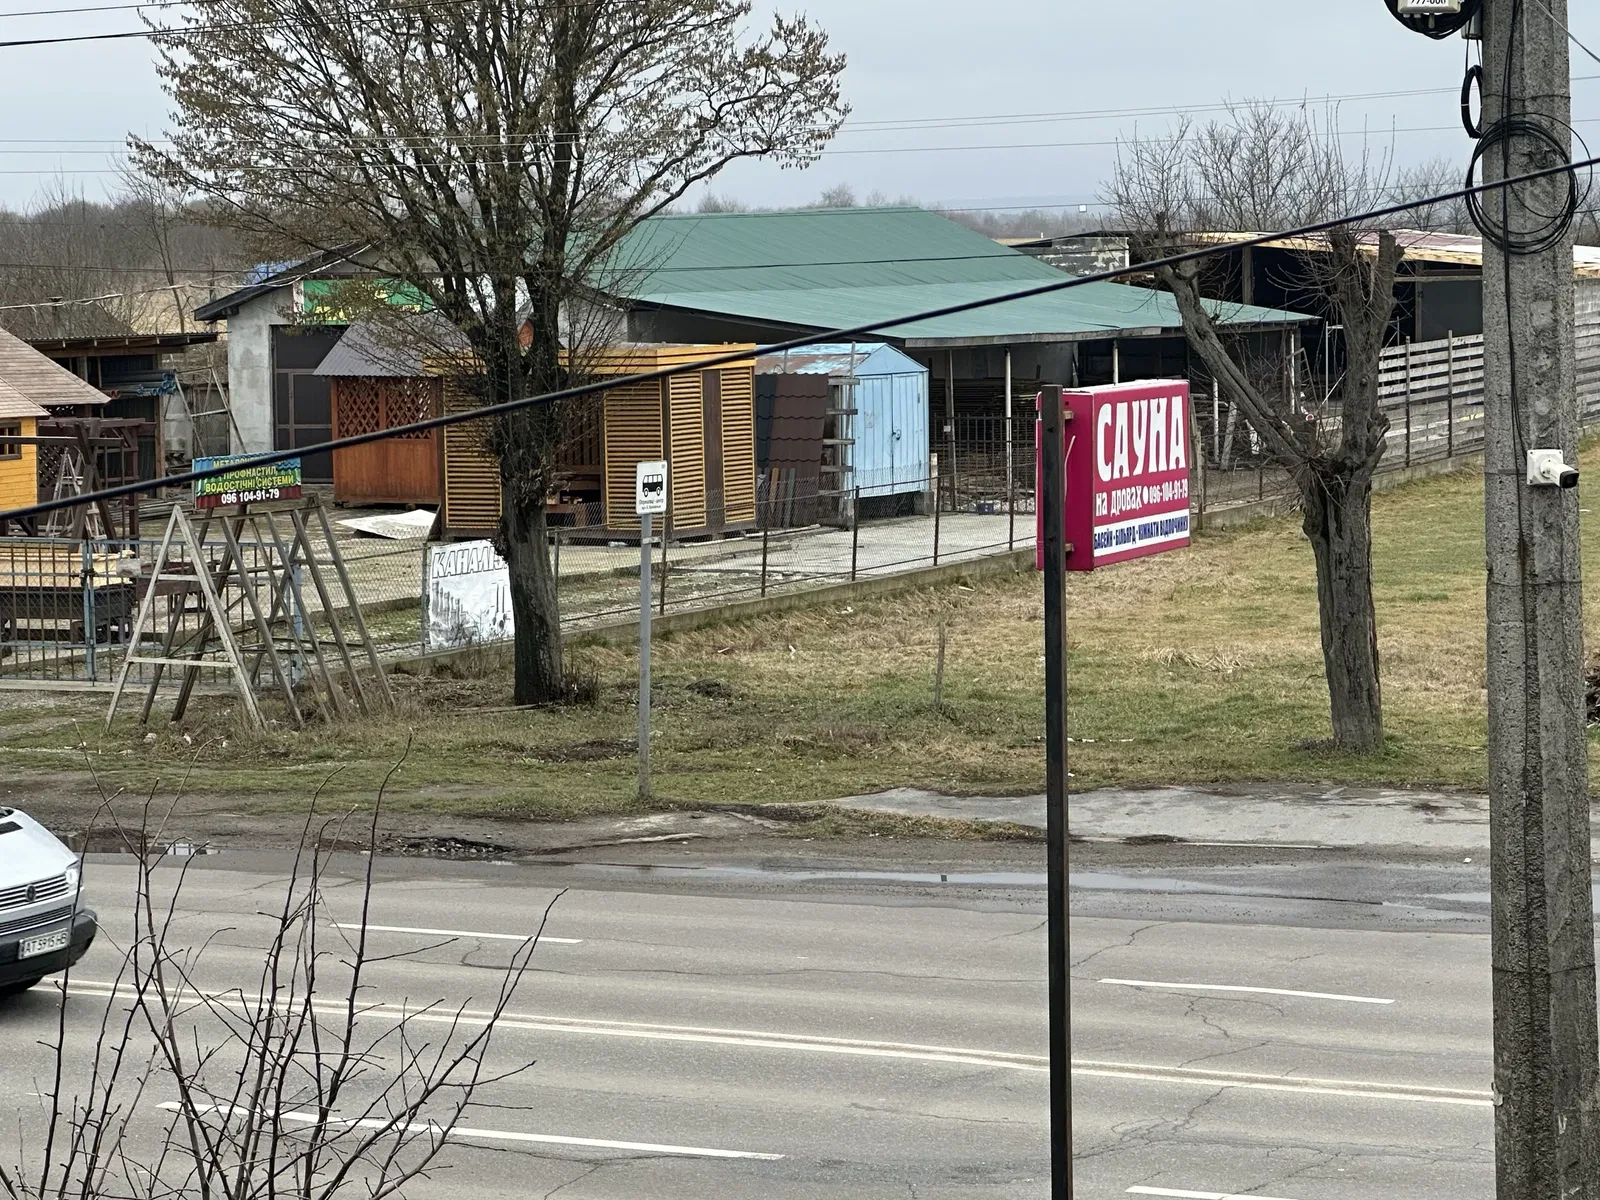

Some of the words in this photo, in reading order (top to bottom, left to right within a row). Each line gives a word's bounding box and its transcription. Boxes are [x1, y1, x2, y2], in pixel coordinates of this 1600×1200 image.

[1097, 395, 1186, 482] САУНА
[205, 479, 256, 493] ВОДОСТІЧНІ
[256, 474, 294, 488] СИСТЕМИ
[221, 493, 237, 505] 096
[239, 488, 280, 502] 104-91-79
[1095, 492, 1108, 517] на
[1110, 485, 1142, 517] дровах
[1149, 478, 1188, 504] 096-104-91-79
[1094, 528, 1113, 550] БАСЕЙН
[24, 940, 37, 953] AT
